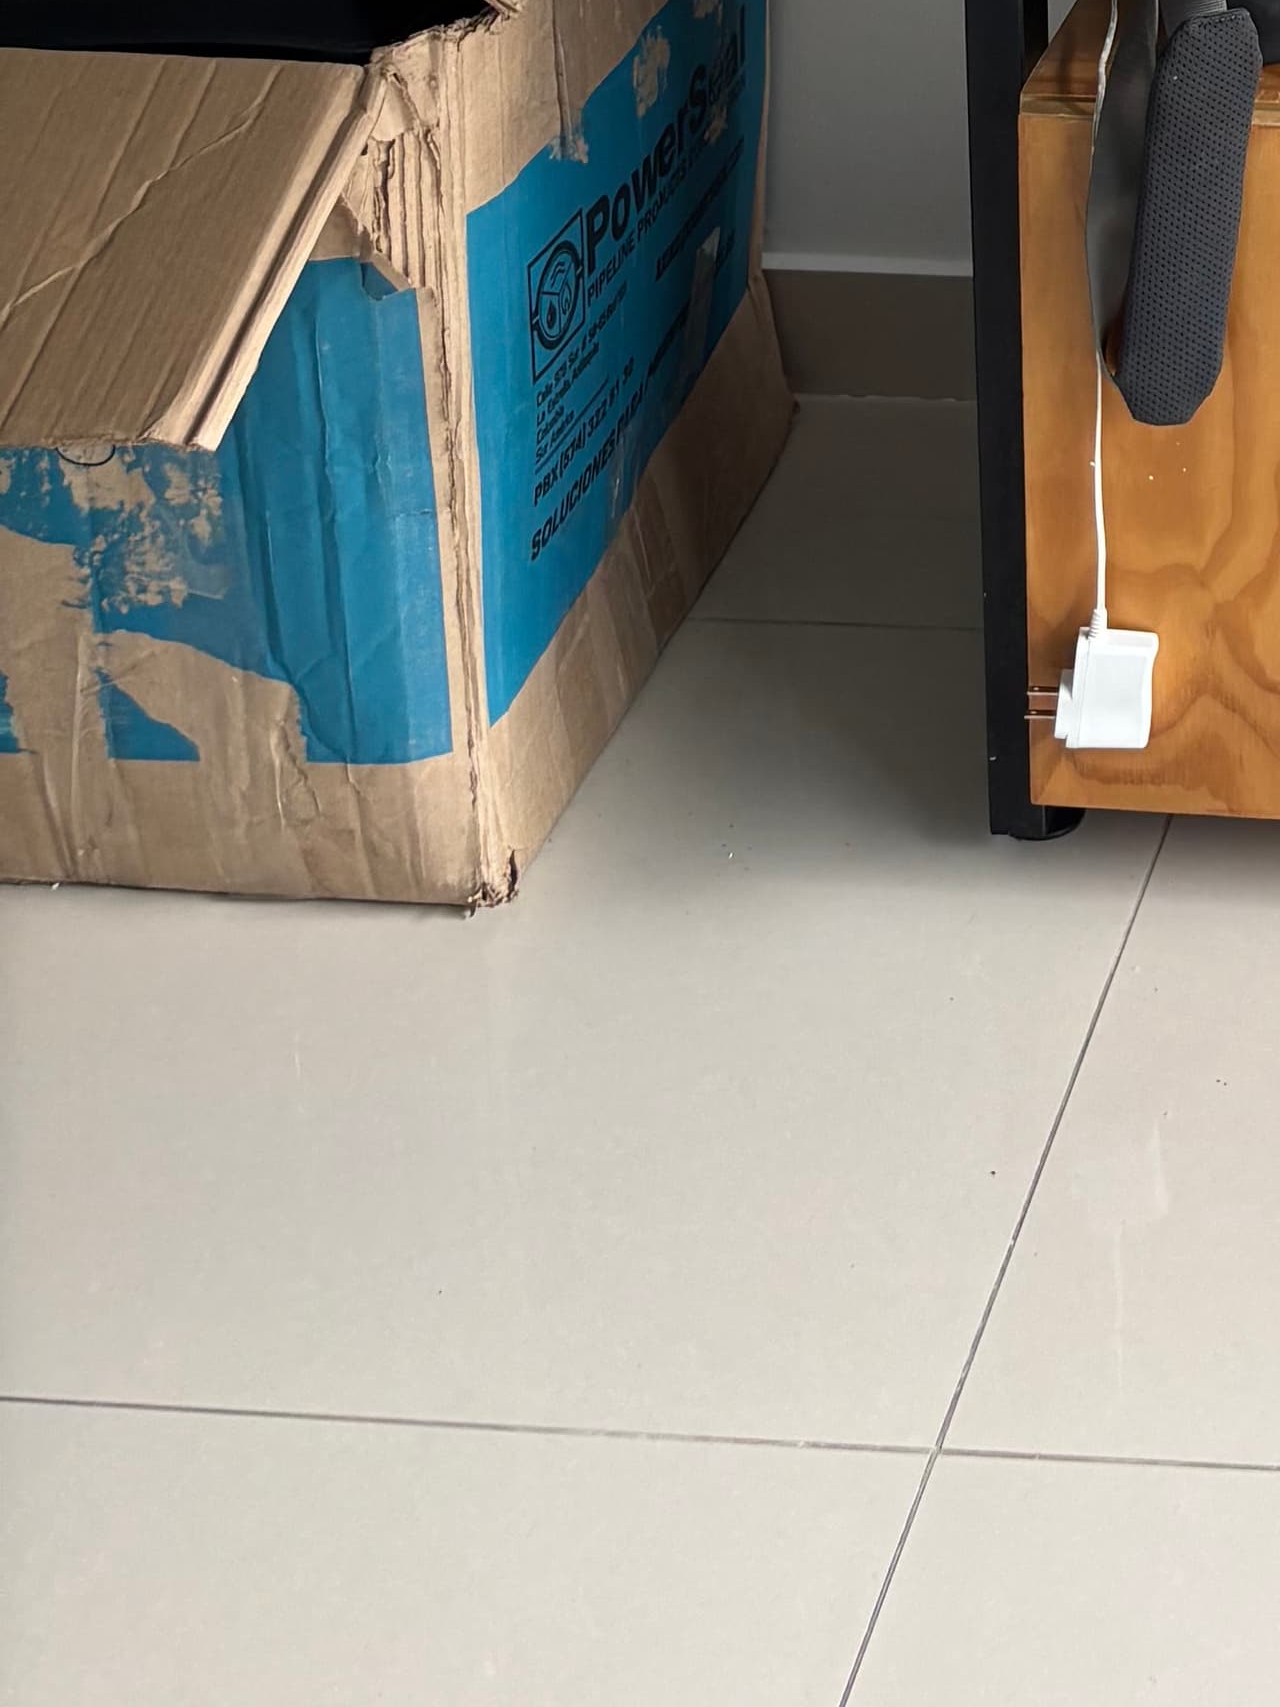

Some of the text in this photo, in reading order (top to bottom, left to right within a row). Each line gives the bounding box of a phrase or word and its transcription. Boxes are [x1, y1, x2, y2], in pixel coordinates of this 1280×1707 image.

[588, 233, 636, 308] PIPELINE
[531, 432, 616, 561] SOLUCIONES
[534, 461, 559, 507] PBX
